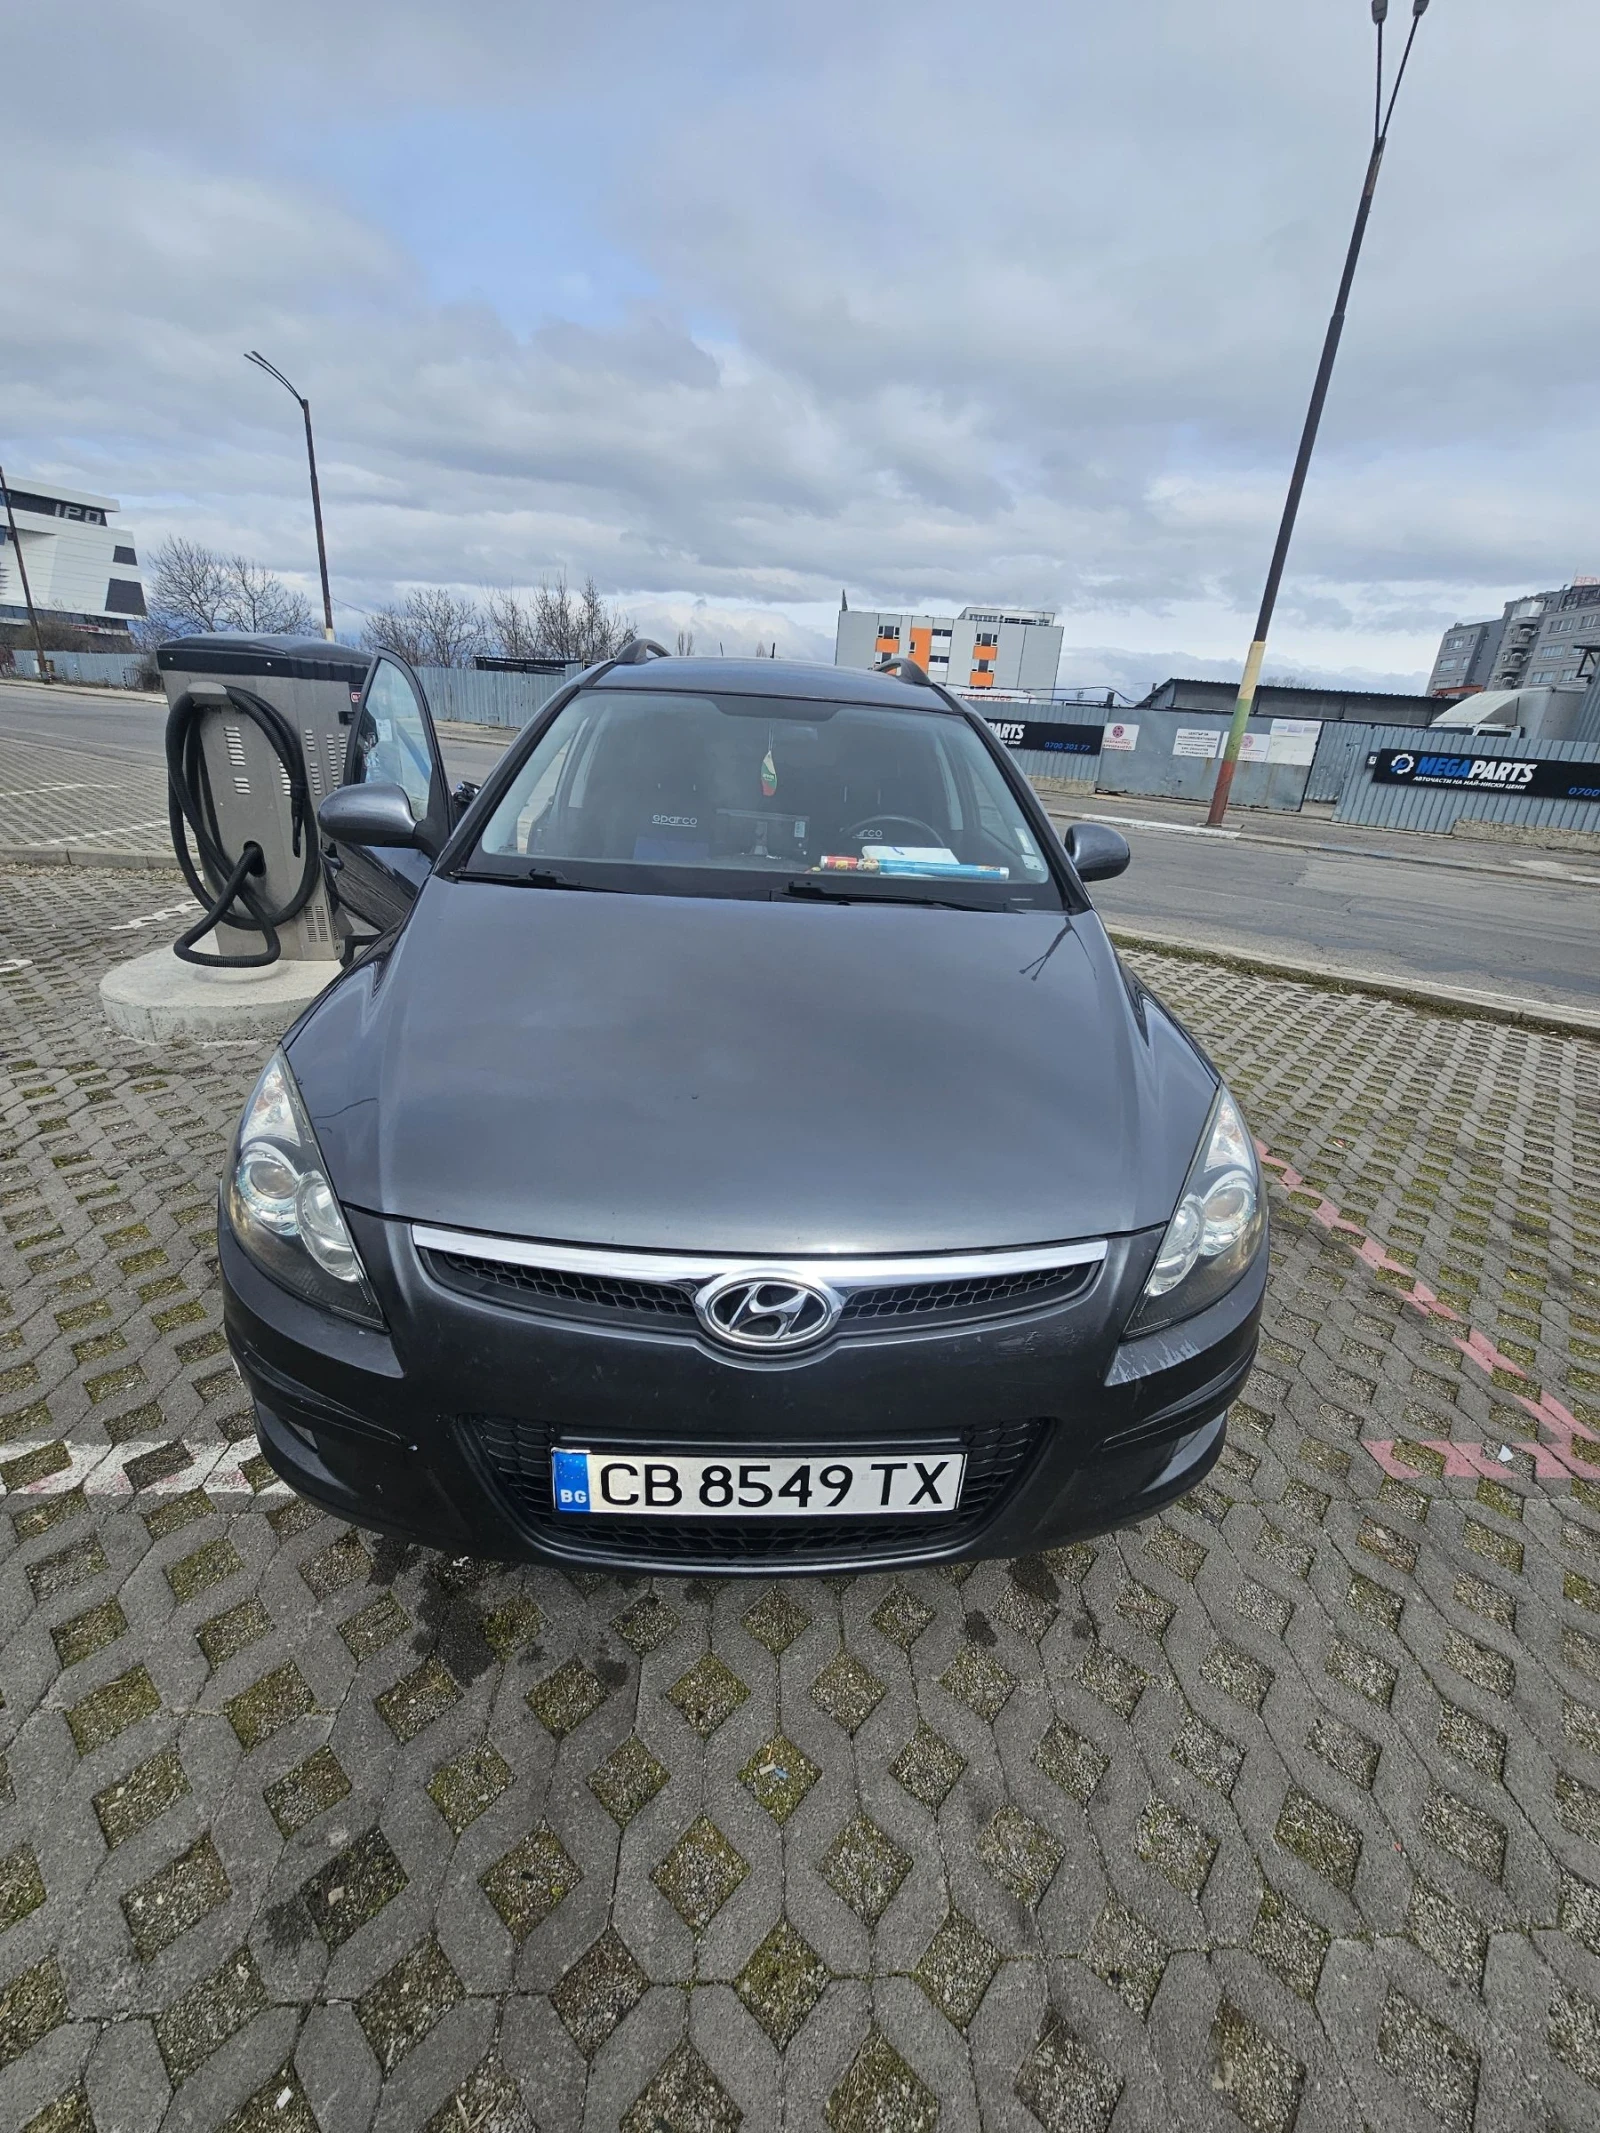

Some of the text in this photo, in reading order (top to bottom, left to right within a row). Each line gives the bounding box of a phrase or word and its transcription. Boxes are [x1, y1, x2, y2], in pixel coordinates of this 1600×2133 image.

[54, 503, 102, 525] IPO
[1044, 741, 1063, 750] 0700
[1415, 756, 1538, 783] MEGAPARTS
[1413, 776, 1452, 784] АВТОЧАСТИ
[1463, 780, 1505, 789] НАЙ-НИСКИ
[1568, 787, 1600, 796] 0700
[600, 1461, 949, 1508] CB 8549 TX
[560, 1488, 587, 1504] BG
